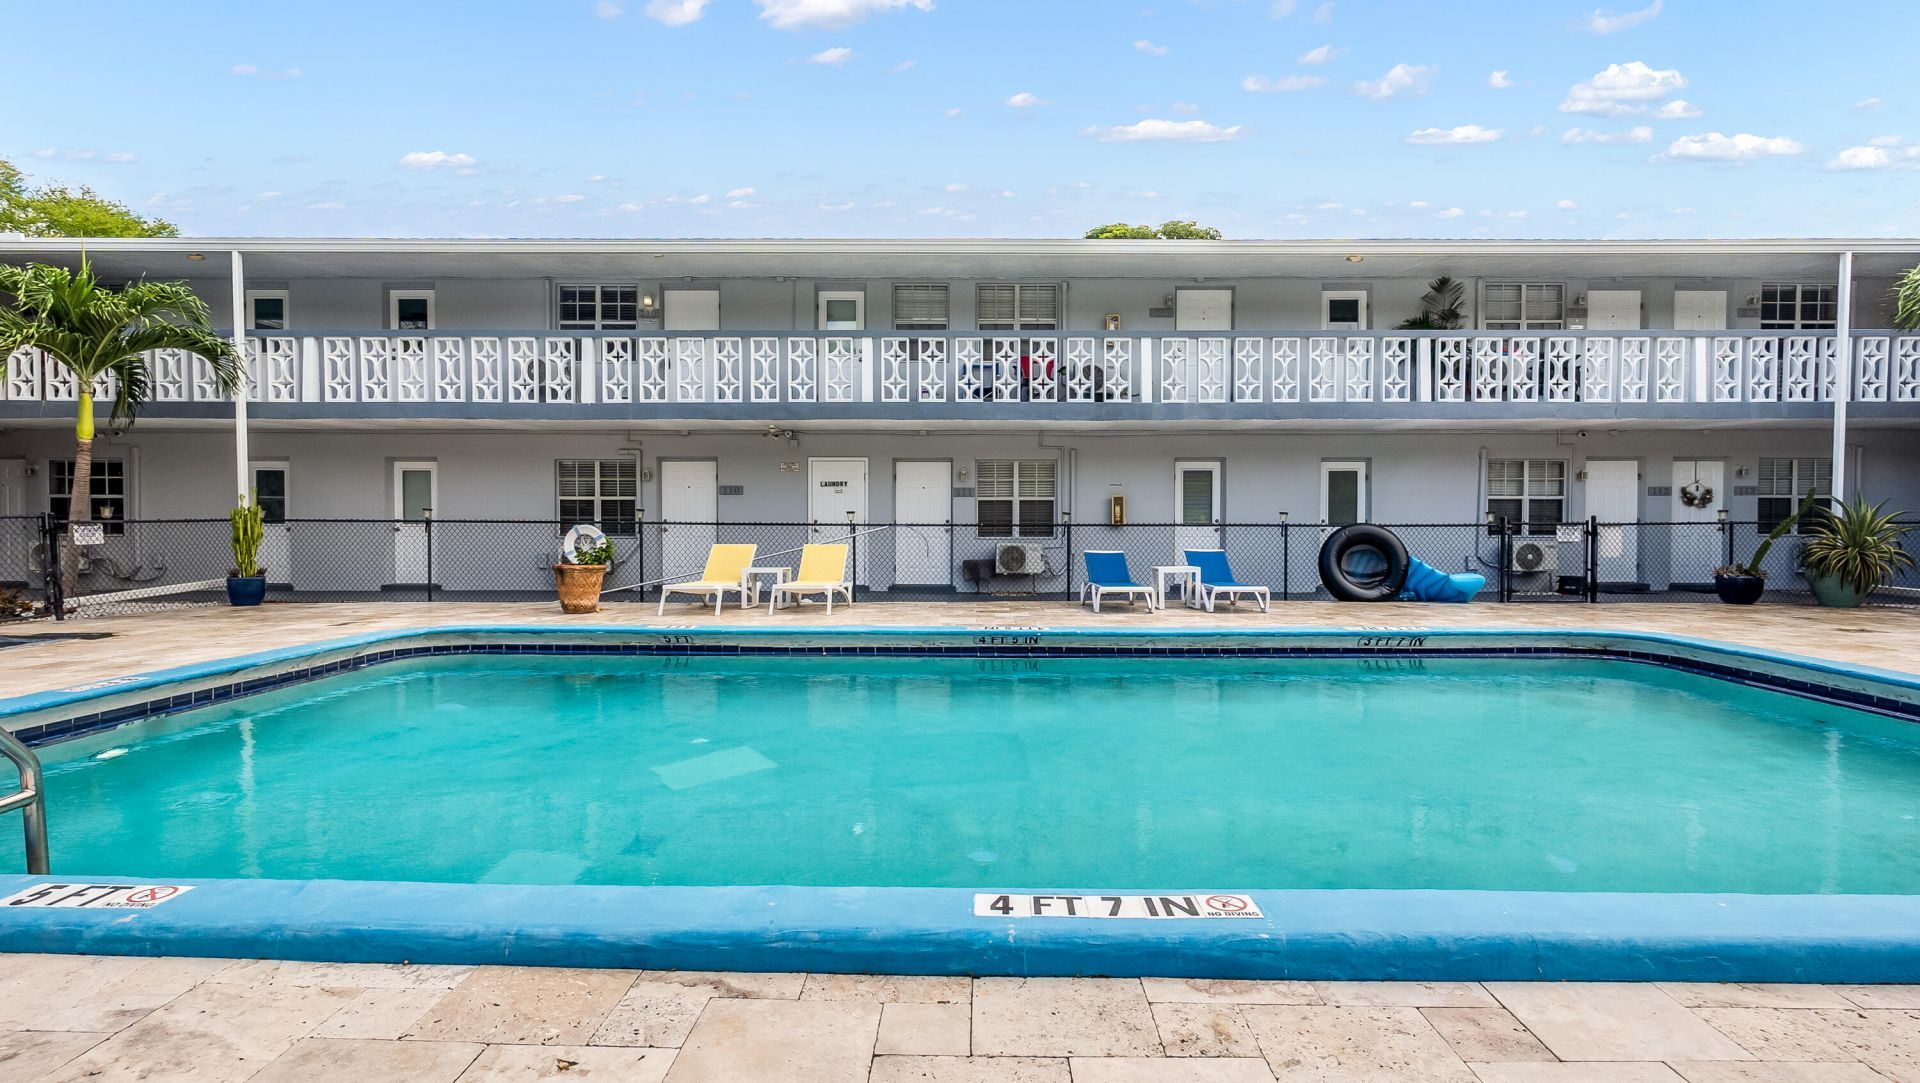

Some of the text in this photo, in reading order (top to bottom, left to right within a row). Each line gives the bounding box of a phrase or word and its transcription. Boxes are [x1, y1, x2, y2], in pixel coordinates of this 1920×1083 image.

[663, 635, 689, 644] 5 FT
[979, 636, 1039, 644] 4 FT 5 IN
[1364, 637, 1427, 646] 3 FT 7 IN
[9, 884, 135, 907] 5 FT
[990, 895, 1200, 917] 4 FT 7 IN
